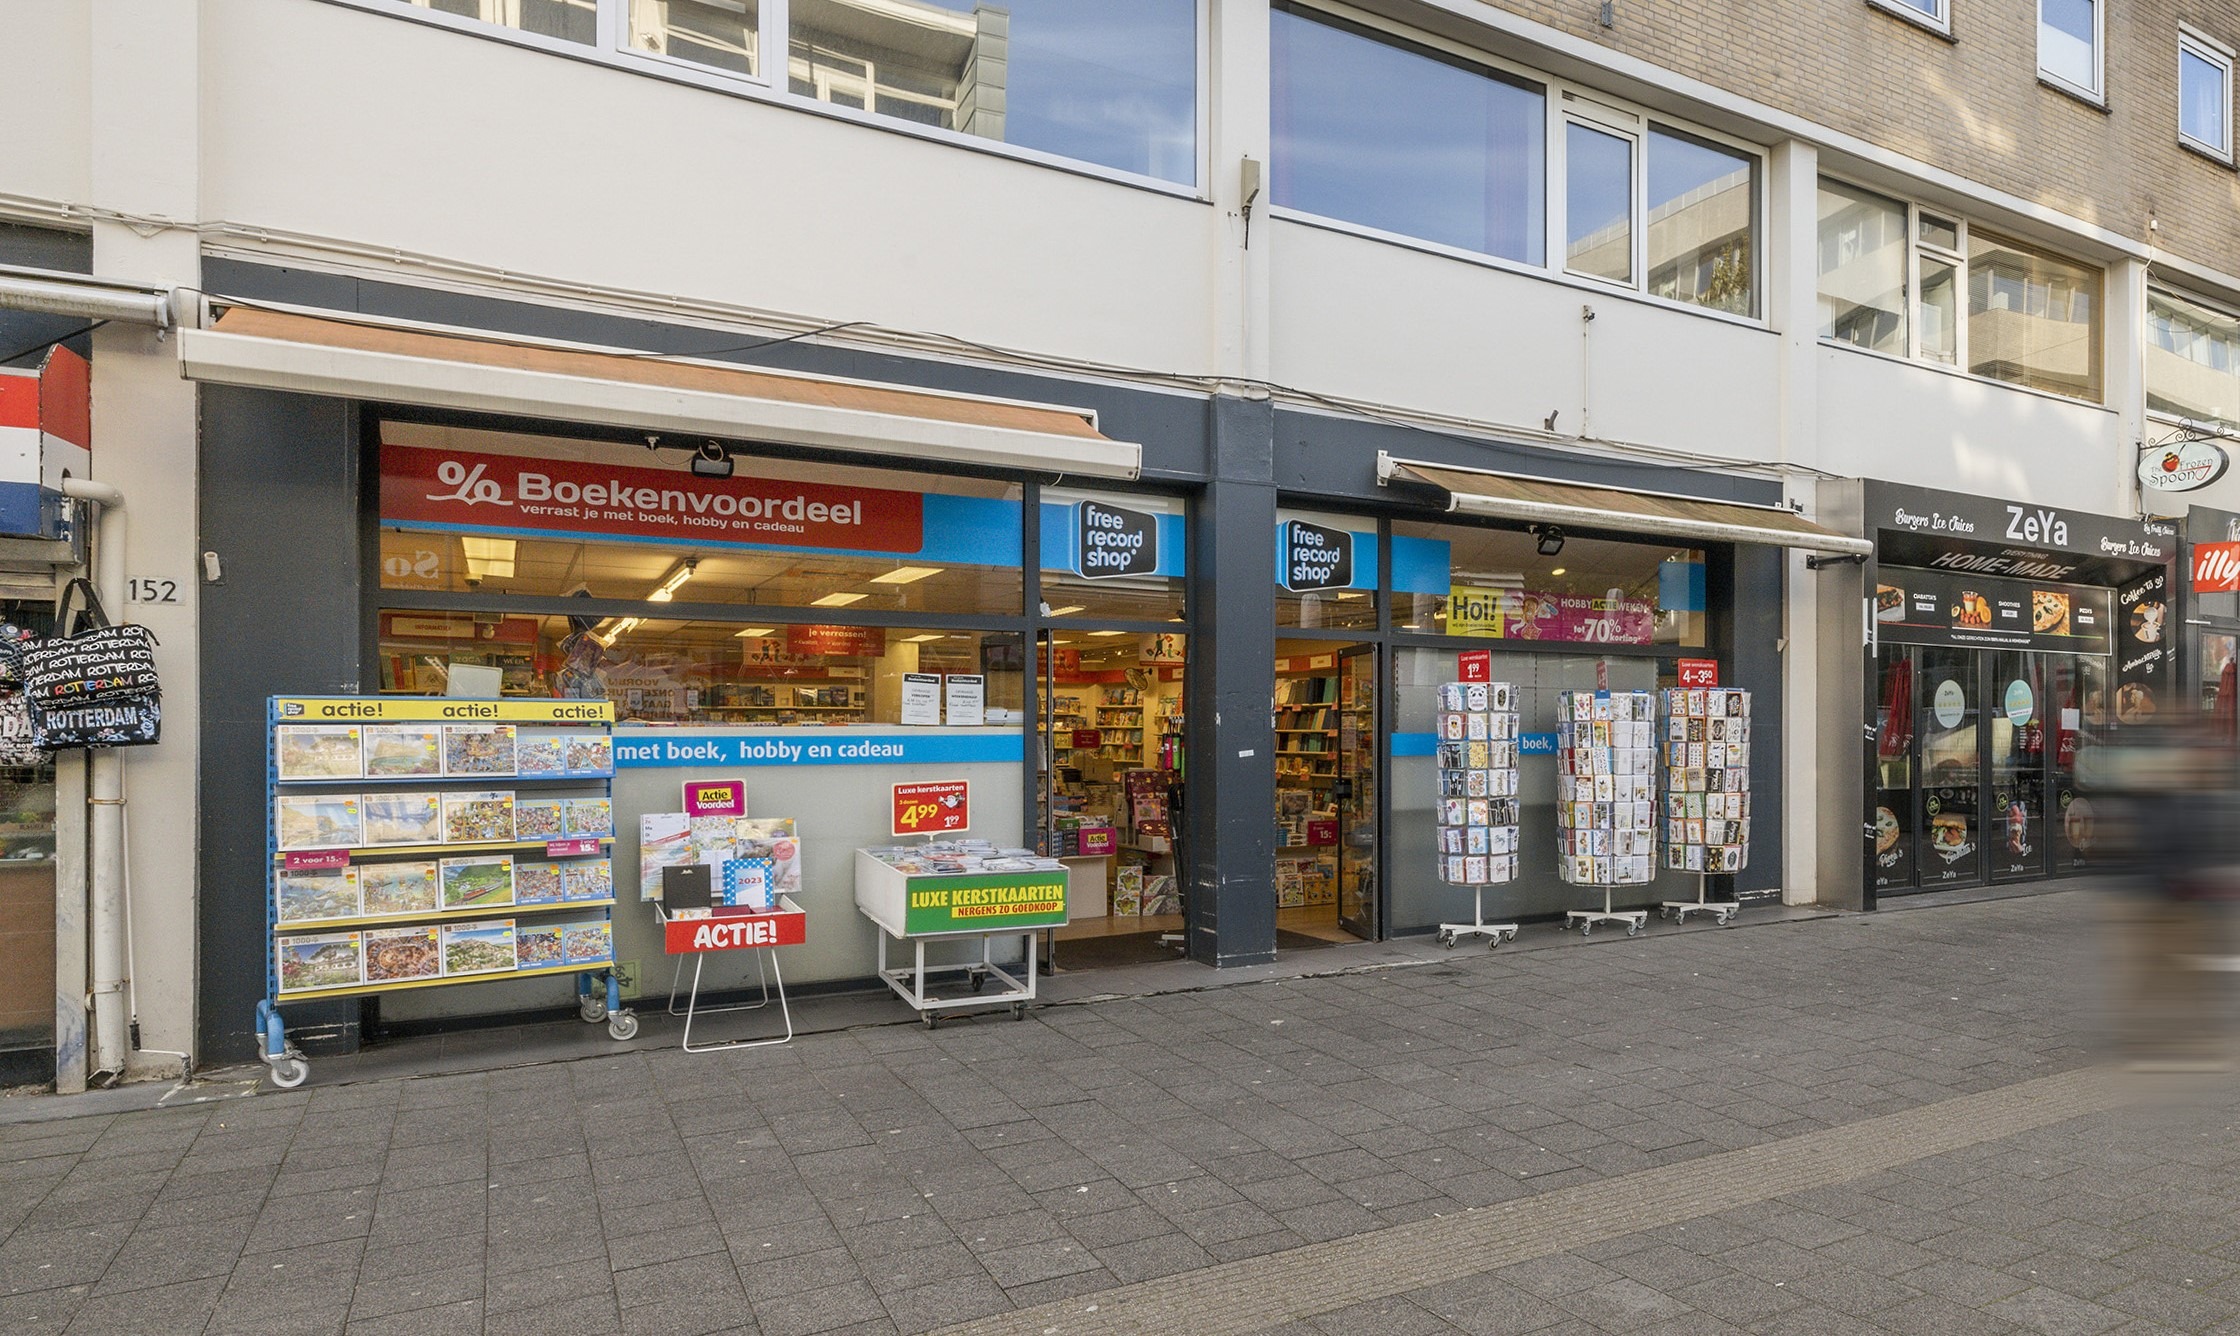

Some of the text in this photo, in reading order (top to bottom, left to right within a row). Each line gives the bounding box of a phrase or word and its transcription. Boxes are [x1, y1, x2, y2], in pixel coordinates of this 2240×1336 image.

[2180, 458, 2213, 468] Frozen
[2150, 472, 2195, 486] Spoon
[518, 472, 862, 525] Boekenvoordeel
[520, 504, 804, 534] verrast je met boek, hobby en cadeau
[1087, 506, 1123, 529] free
[1895, 508, 1974, 532] Burgers Ice Juices
[2006, 505, 2068, 546] ZeYa
[1087, 531, 1142, 548] record
[1293, 524, 1323, 546] free
[1293, 546, 1340, 564] record
[2100, 536, 2161, 557] Burgers Ice Juices
[1930, 552, 2076, 579] HOME-MADE
[2197, 550, 2240, 587] illy
[130, 580, 176, 602] 152
[2121, 585, 2145, 604] Coffee
[1453, 596, 1497, 621] Hoi!
[820, 630, 866, 638] verrassen!
[1574, 625, 1584, 633] tot
[49, 651, 125, 669] ROTTERDAM
[1683, 670, 1690, 682] 4
[54, 675, 133, 696] ROTTERDAM
[46, 706, 138, 730] ROTTERDAM
[322, 703, 383, 717] actie!
[443, 704, 498, 718] actie!
[553, 705, 603, 719] actie!
[616, 740, 904, 763] met boek, hobby en cadeau
[1523, 736, 1552, 751] boek,
[702, 790, 728, 800] Actie
[918, 784, 964, 793] kerstkaarten
[697, 800, 734, 809] Voordeel
[1942, 870, 1956, 879] ZeYa
[2011, 864, 2024, 872] ZeYa
[738, 877, 762, 885] 2023
[912, 885, 1063, 908] LUXE KERSTKAARTEN
[958, 902, 1057, 916] NERGENS ZO GOEDKOOP
[694, 920, 777, 948] ACTIE!
